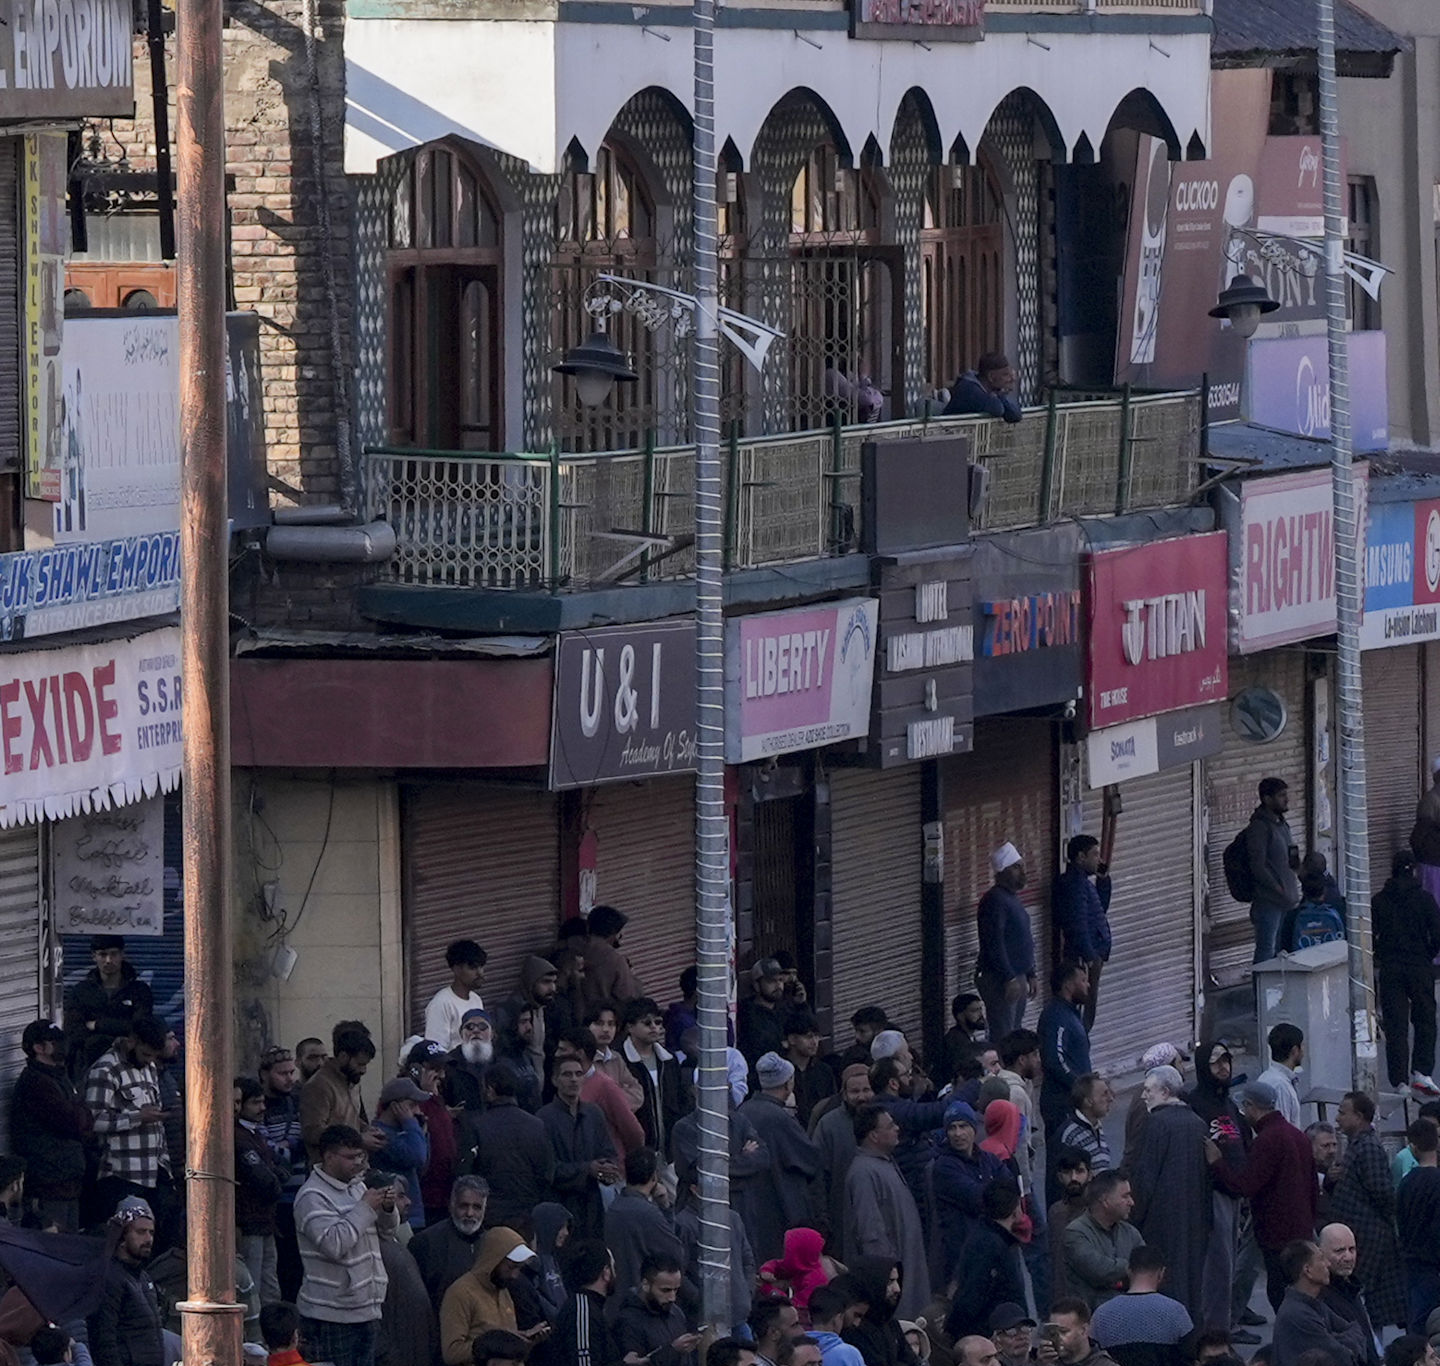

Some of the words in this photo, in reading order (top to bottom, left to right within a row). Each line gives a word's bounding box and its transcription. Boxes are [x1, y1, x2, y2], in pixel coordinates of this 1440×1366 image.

[13, 0, 131, 89] EMPORIUM
[1176, 181, 1219, 211] CUCKOO
[31, 319, 41, 497] EMPORIUM
[3, 558, 30, 609] JK
[37, 546, 101, 604] SHAWL
[1365, 541, 1411, 588] AMSUNG
[105, 598, 140, 621] BACK
[983, 596, 1031, 656] ZERO
[1030, 589, 1081, 650] POINT
[1146, 589, 1206, 661] TITAN
[580, 648, 604, 738] U
[615, 644, 638, 735] &
[650, 643, 661, 729] I
[746, 629, 830, 700] LIBERTY
[0, 659, 122, 776] EXIDE
[137, 721, 183, 751] ENTERPRI
